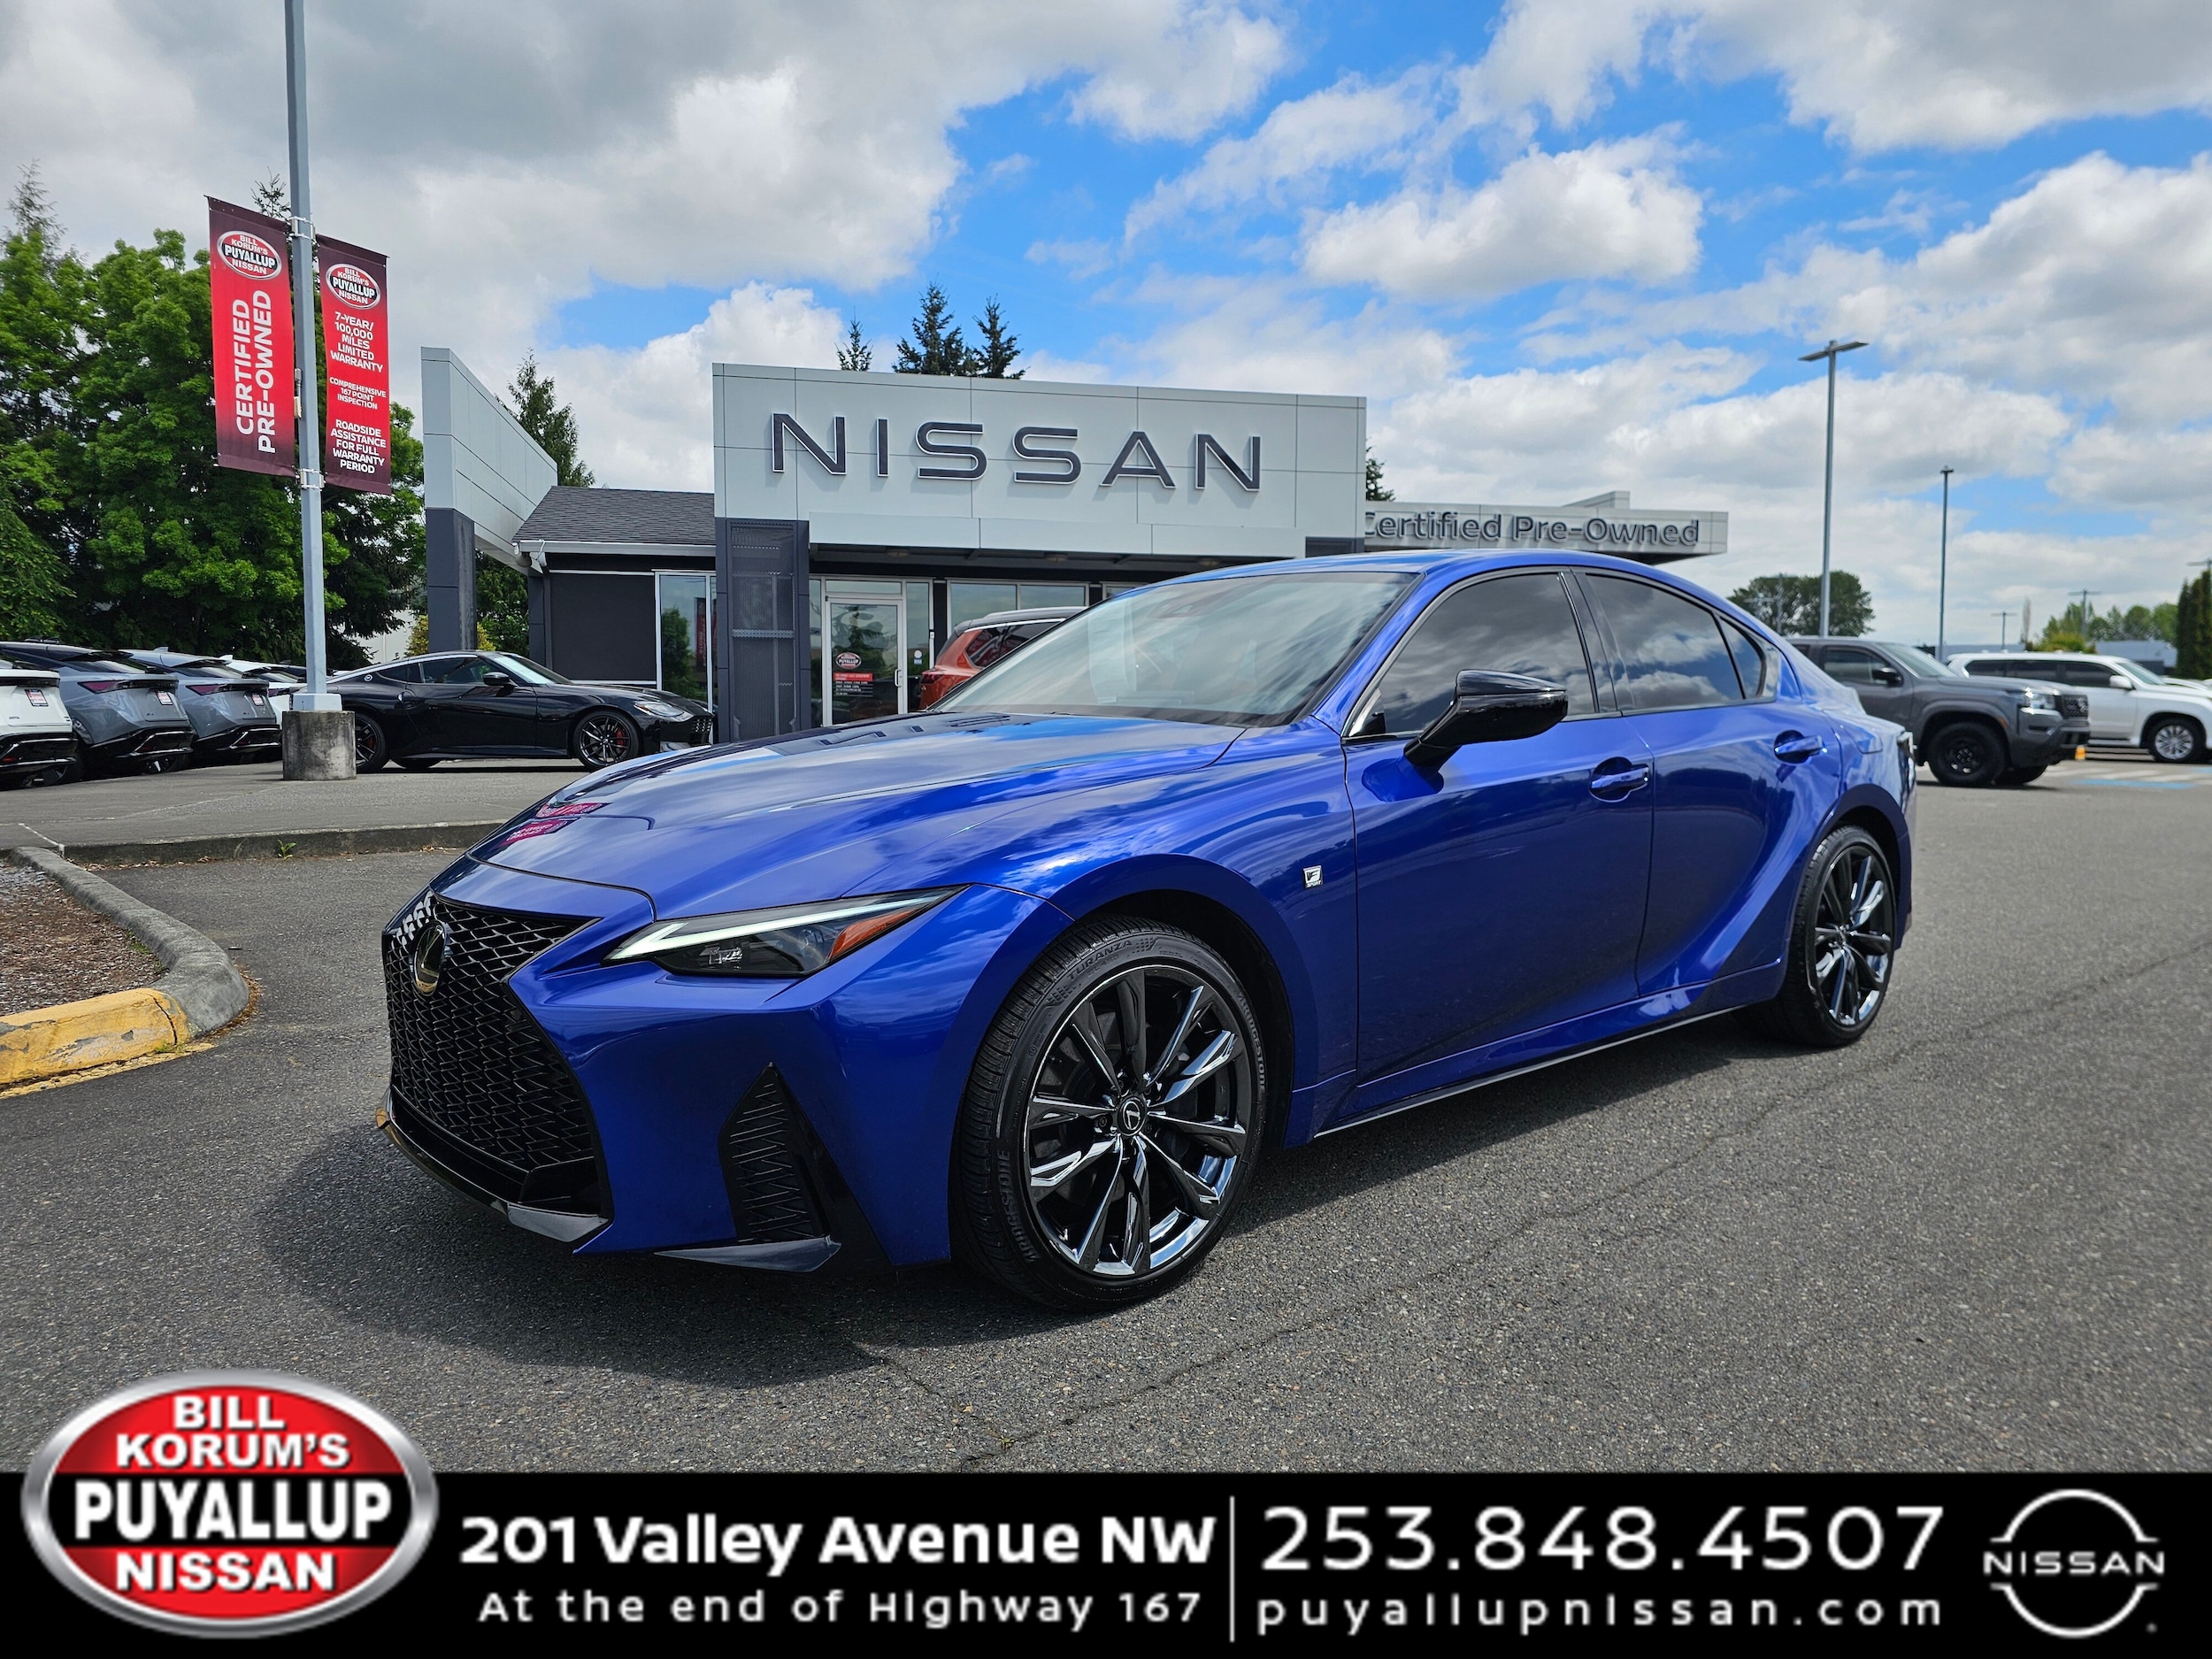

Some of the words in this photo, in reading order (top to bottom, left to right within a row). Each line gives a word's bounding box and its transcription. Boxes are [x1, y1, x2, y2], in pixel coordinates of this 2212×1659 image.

[232, 239, 268, 255] KORUM'S
[240, 235, 257, 246] BILL
[225, 244, 275, 268] PUYALLUP
[233, 258, 267, 274] NISSAN
[345, 268, 360, 277] BILL
[333, 277, 375, 298] PUYALLUP
[338, 272, 369, 286] KORUM'S
[339, 290, 368, 304] NISSAN
[335, 311, 373, 331] 7-YEAR/
[334, 322, 373, 341] 100,000
[342, 334, 370, 349] MILES
[338, 342, 374, 361] LIMITED
[233, 299, 254, 434] CERTIFIED
[330, 350, 383, 373] WARRANTY
[253, 290, 275, 453] PRE-OWNED
[330, 377, 387, 397] COMPREHENSIVE
[352, 391, 374, 401] POINT
[338, 394, 378, 410] INSPECTION
[336, 419, 381, 437] ROADSIDE
[331, 428, 387, 448] ASSISTANCE
[336, 439, 355, 450] FOR
[357, 444, 379, 456] FULL
[772, 413, 1262, 491] NISSAN
[333, 448, 385, 466] WARRANTY
[341, 459, 375, 473] PERIOD
[1514, 516, 1700, 543] Pre-Owned
[1067, 940, 1133, 980] TURANZA
